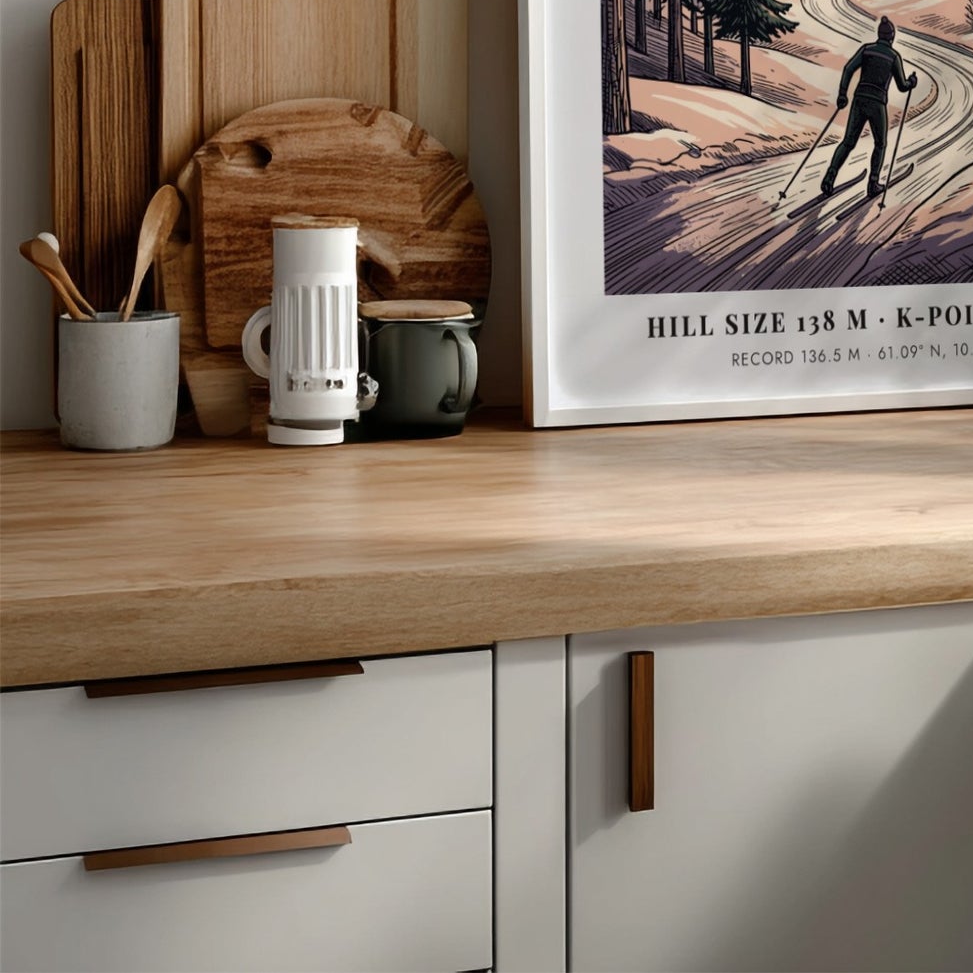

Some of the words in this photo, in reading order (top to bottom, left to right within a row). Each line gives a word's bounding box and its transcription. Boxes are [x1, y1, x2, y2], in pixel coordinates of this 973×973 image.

[647, 315, 714, 338] HILL
[725, 312, 785, 335] SIZE
[797, 310, 836, 336] 138
[847, 309, 867, 331] M
[731, 350, 794, 367] RECORD
[801, 347, 842, 364] 136.5
[848, 346, 860, 362] M
[878, 344, 924, 361] 61.09°
[930, 343, 946, 360] N,
